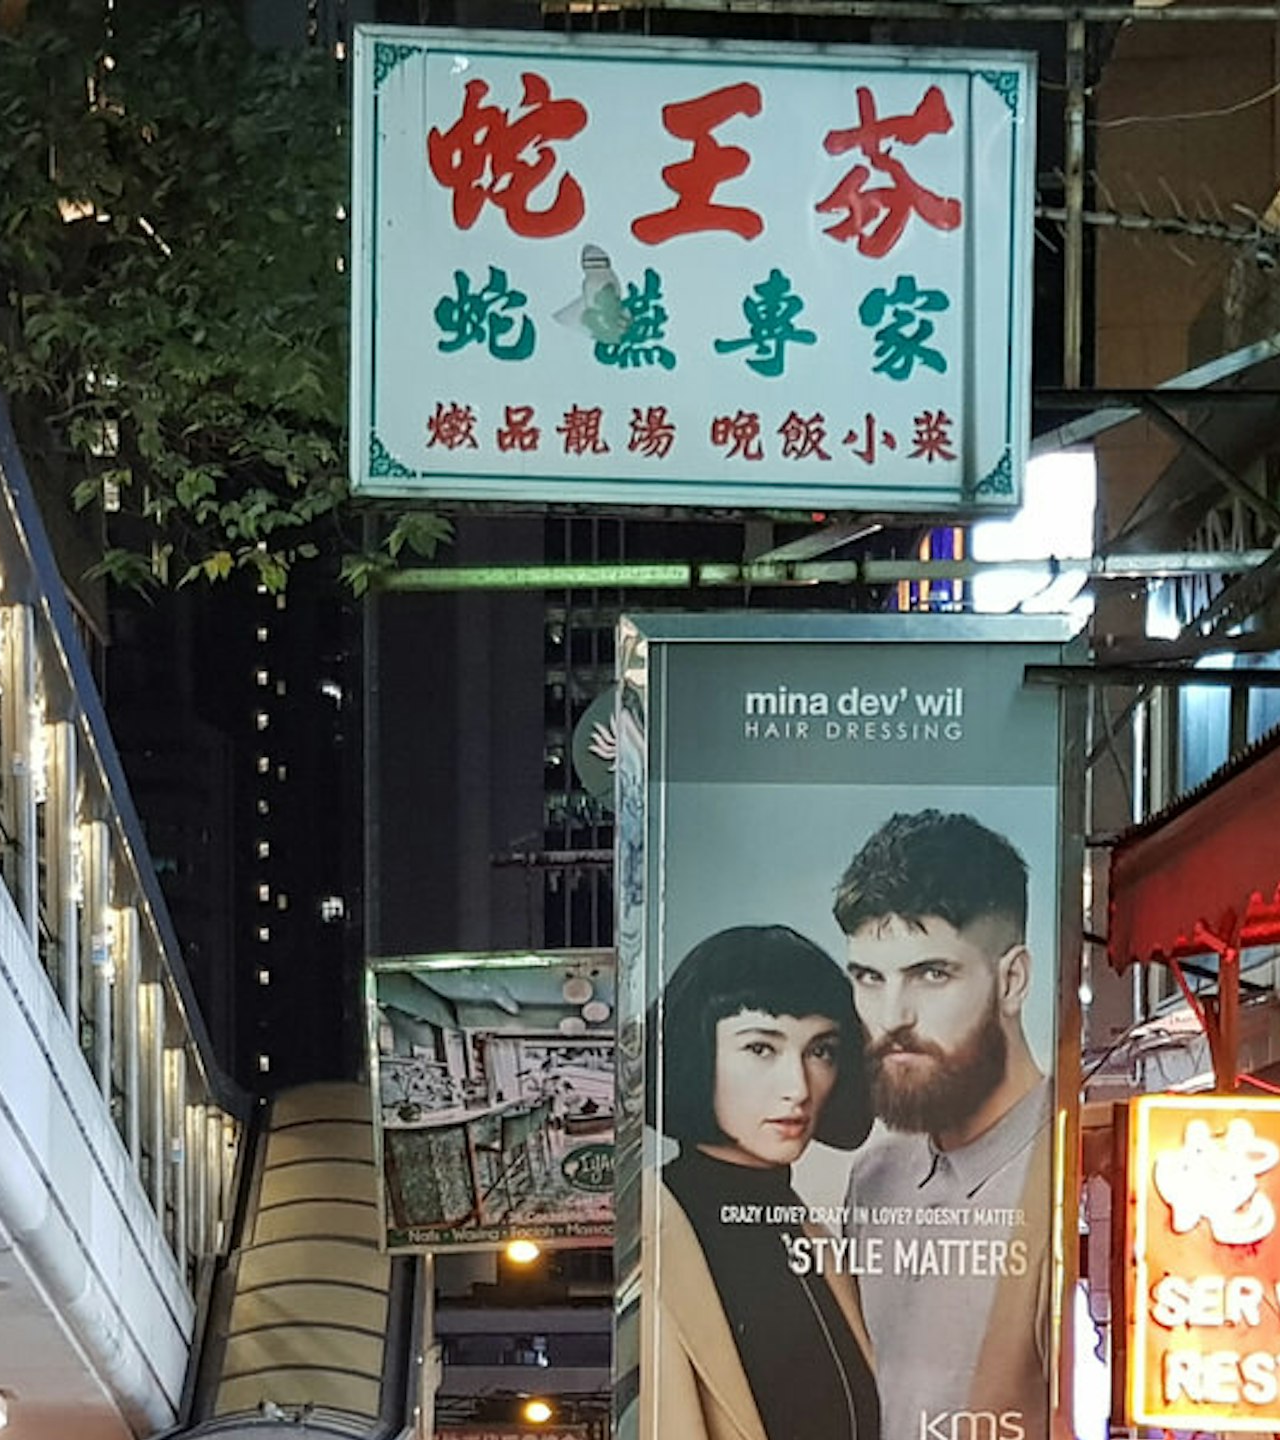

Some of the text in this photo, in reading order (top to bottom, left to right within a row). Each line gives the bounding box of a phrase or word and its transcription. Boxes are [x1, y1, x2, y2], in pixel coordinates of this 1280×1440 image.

[426, 72, 962, 258] 蛇王芬
[709, 410, 958, 466] 晚飯小菜
[745, 686, 828, 716] mina
[914, 687, 963, 717] wil
[744, 721, 963, 741] HAIR DRESSING
[720, 1204, 763, 1224] CRAZY
[766, 1205, 807, 1224] LOVE?
[809, 1206, 850, 1225] CRAZY
[853, 1207, 869, 1225] IN
[871, 1207, 911, 1226] LOVE?
[893, 1238, 1028, 1276] MATTERS
[1152, 1276, 1265, 1328] SER
